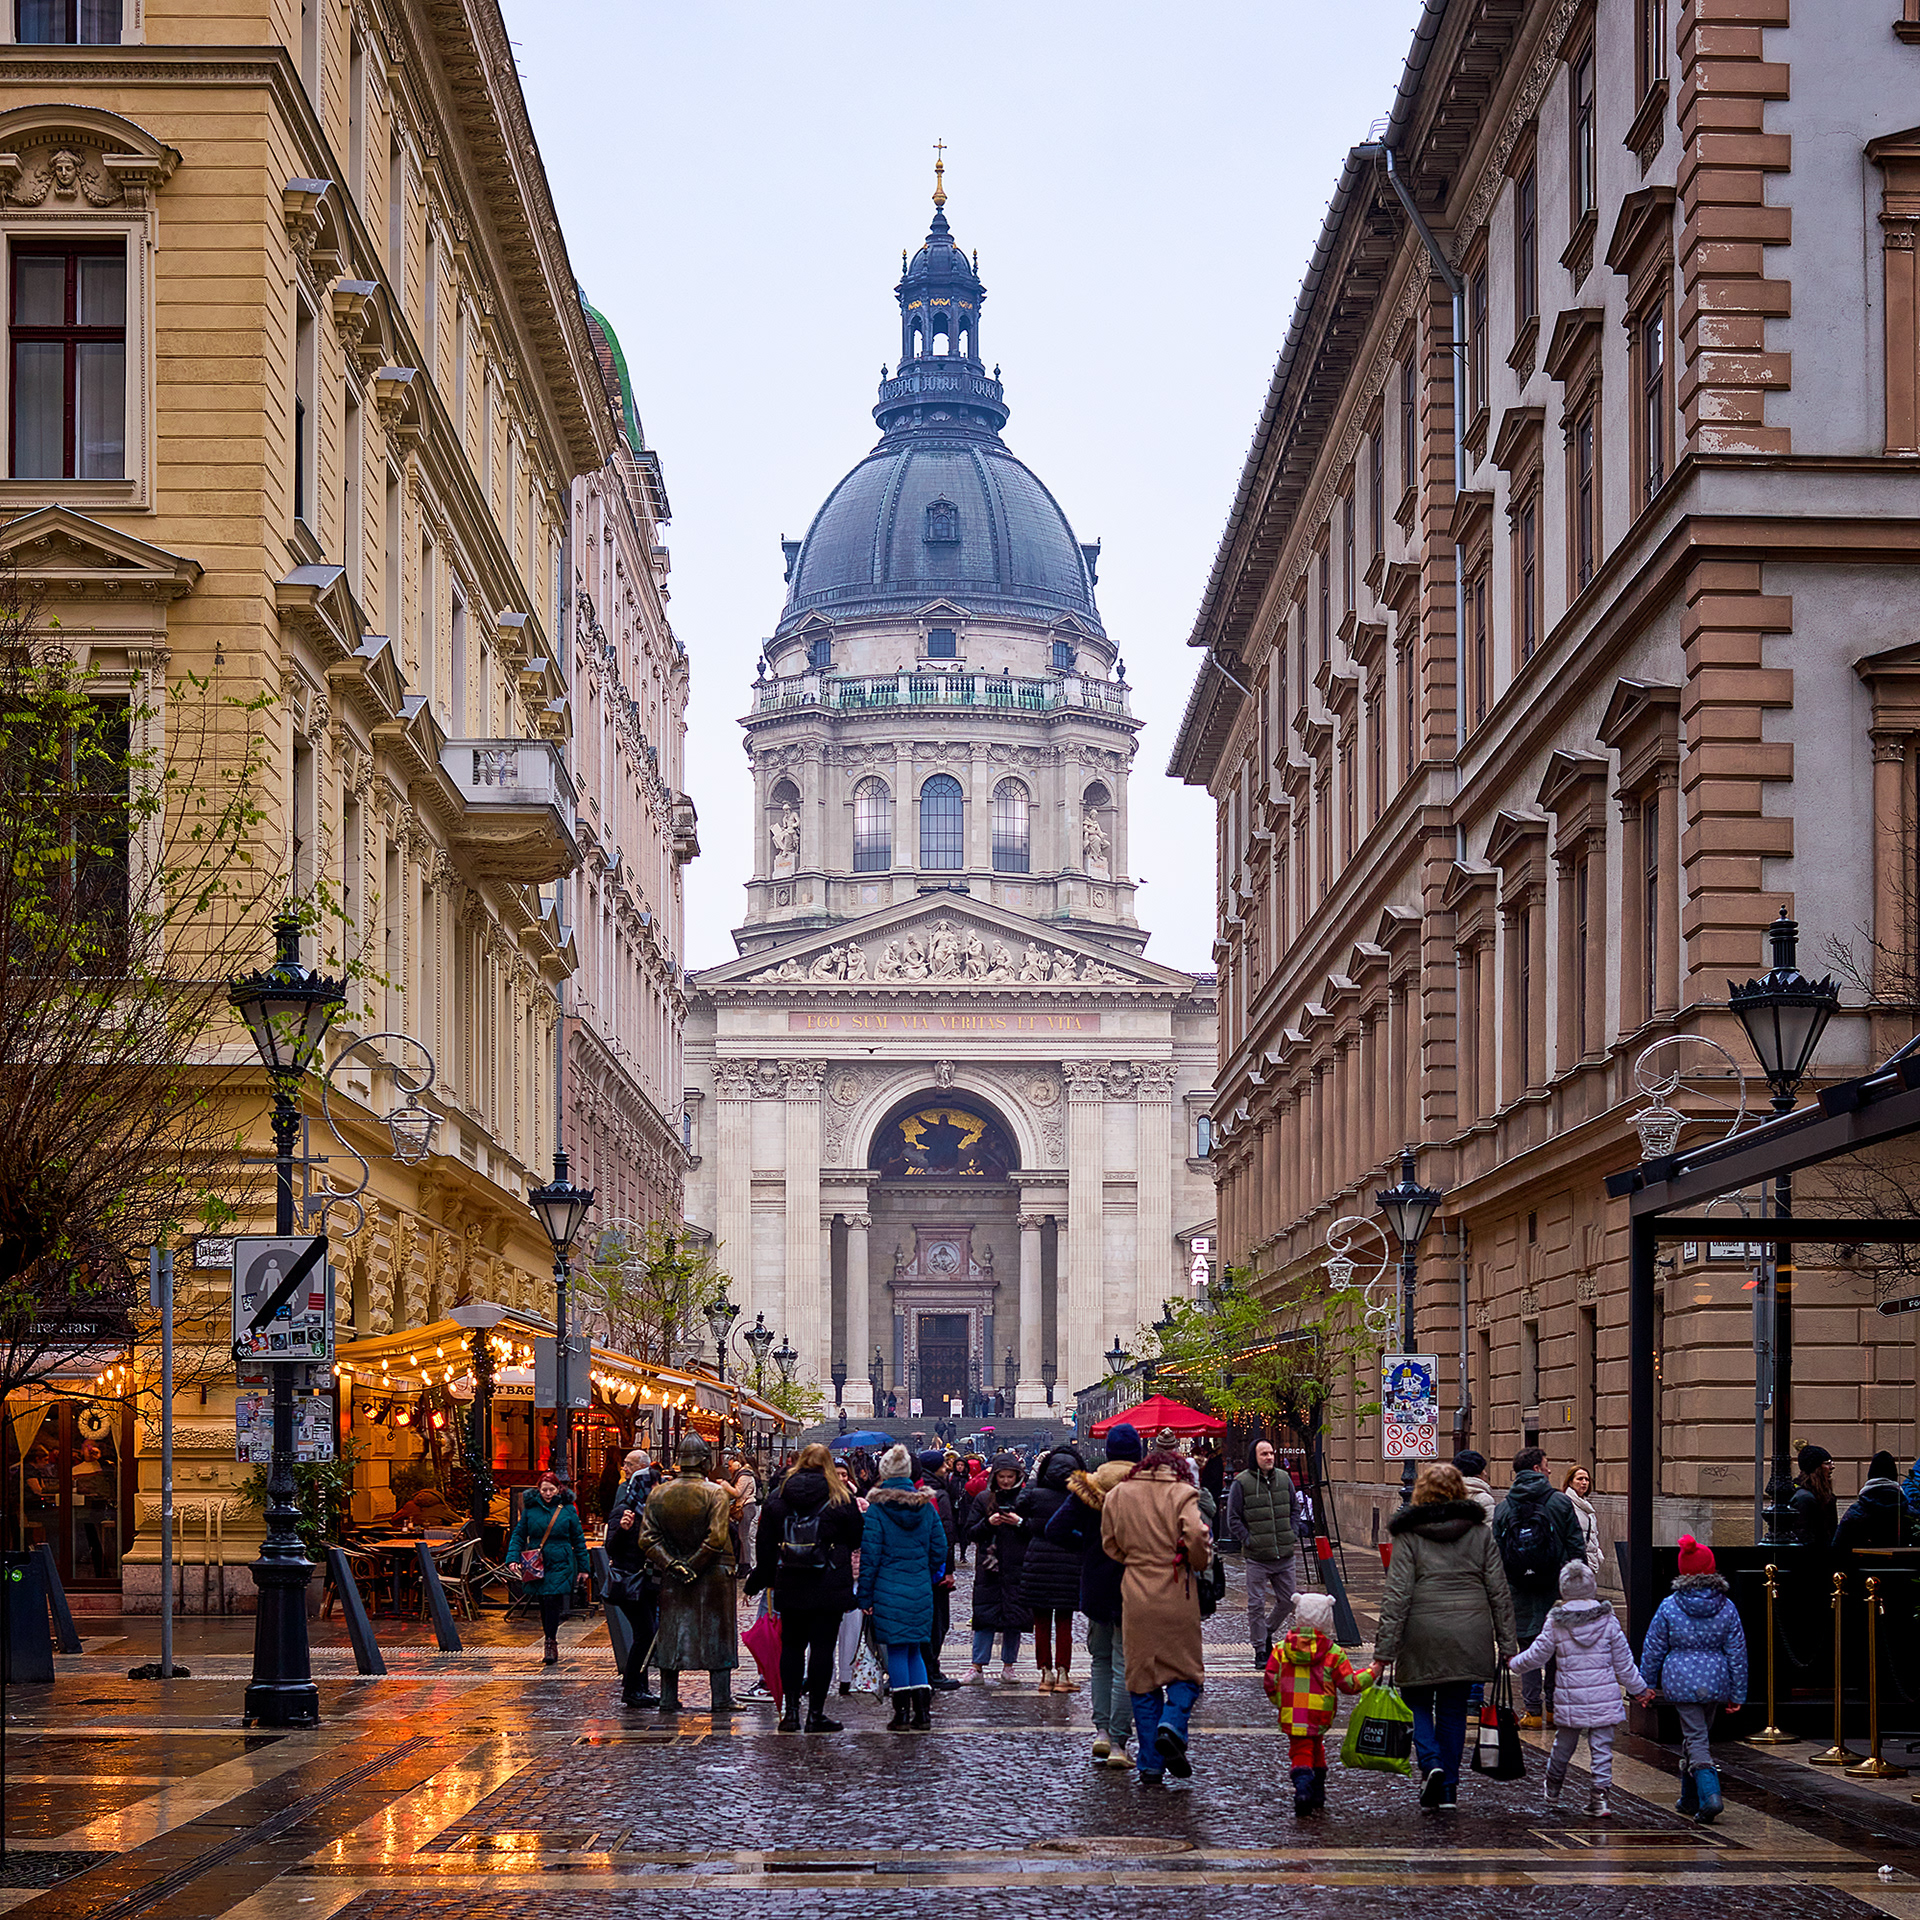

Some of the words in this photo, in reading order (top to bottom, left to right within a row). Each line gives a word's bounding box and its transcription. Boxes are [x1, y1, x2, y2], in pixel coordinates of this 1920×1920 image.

[806, 1015, 840, 1029] EGO
[852, 1015, 888, 1029] SUM
[901, 1015, 929, 1029] VIA
[939, 1015, 1006, 1029] VERITAS
[1017, 1015, 1036, 1029] ET
[1047, 1015, 1082, 1030] VITA
[506, 1385, 535, 1395] BAG
